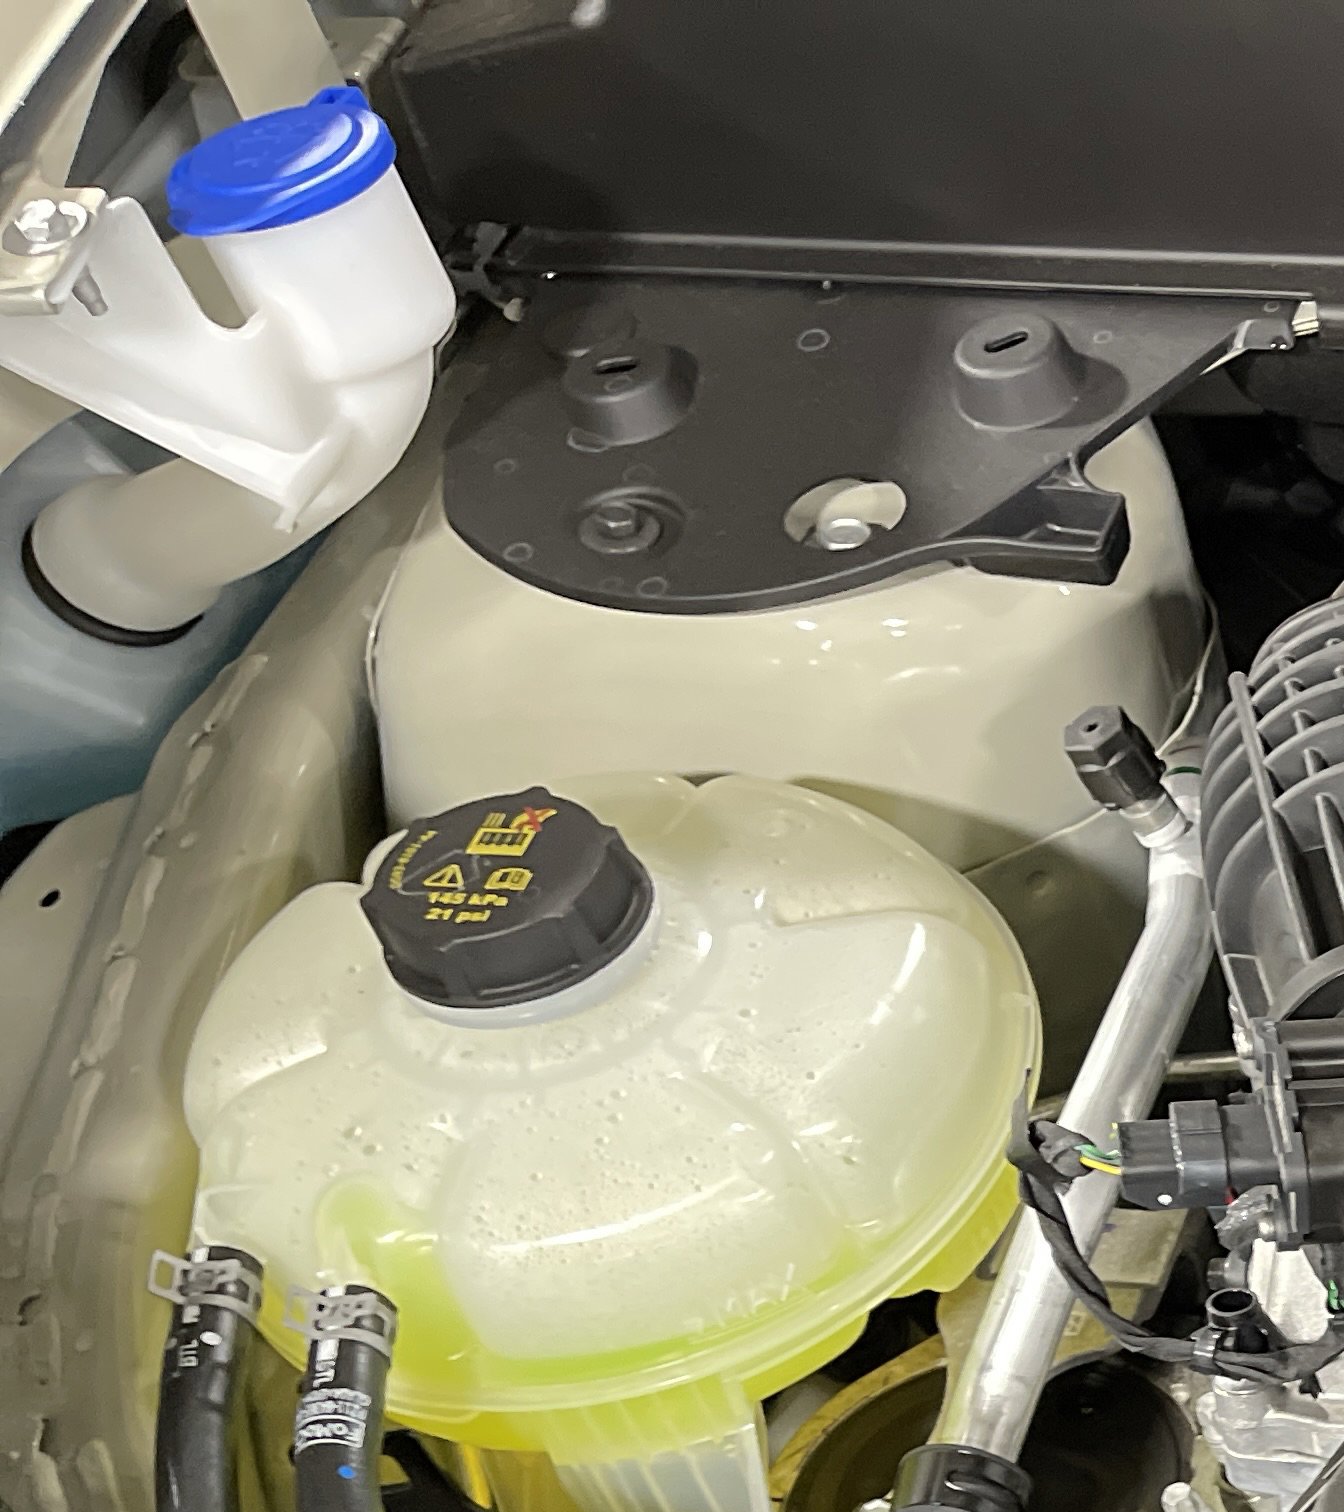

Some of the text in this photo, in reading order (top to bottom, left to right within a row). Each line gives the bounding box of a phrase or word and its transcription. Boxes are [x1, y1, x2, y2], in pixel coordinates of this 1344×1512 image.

[426, 891, 508, 907] 145 kPa
[423, 907, 491, 924] 21 psi
